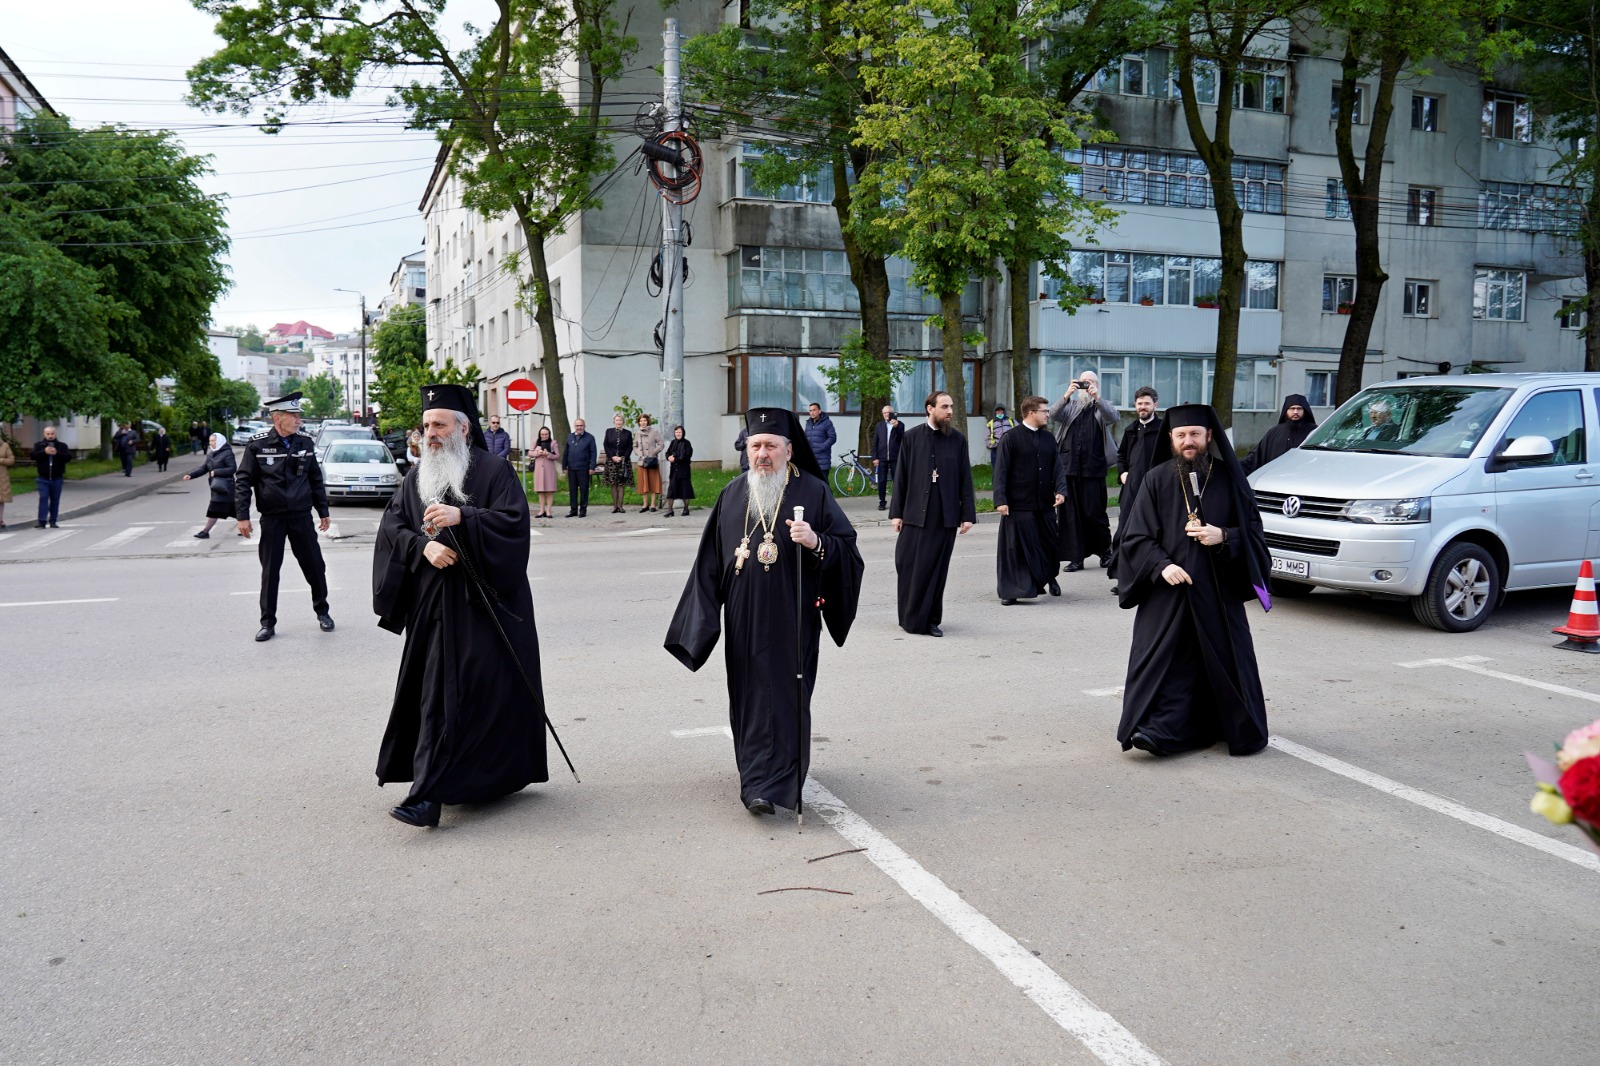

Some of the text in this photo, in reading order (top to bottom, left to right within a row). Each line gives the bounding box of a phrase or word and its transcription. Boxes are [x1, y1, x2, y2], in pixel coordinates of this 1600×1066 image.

[1283, 496, 1300, 517] VW
[1272, 558, 1304, 574] 03 MMB
